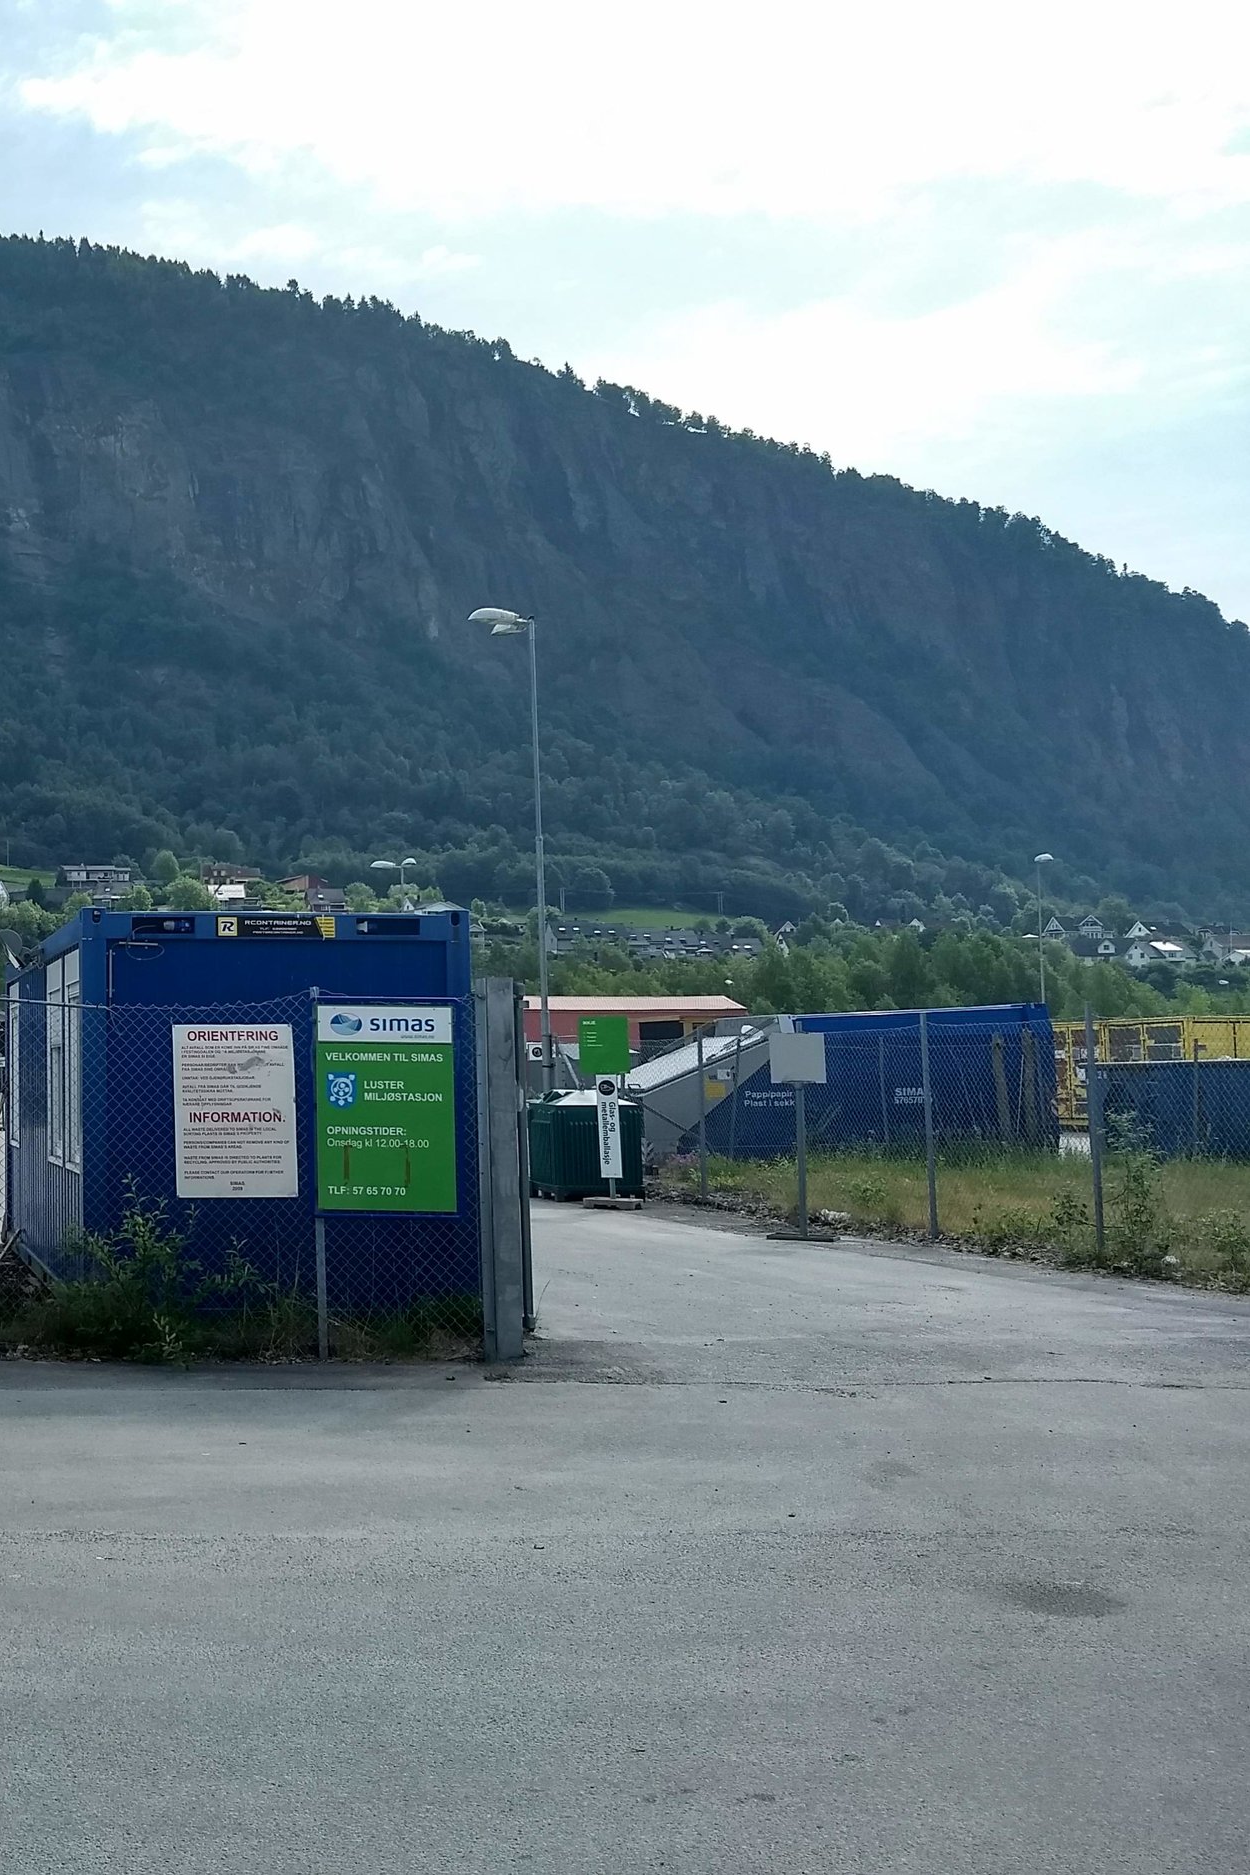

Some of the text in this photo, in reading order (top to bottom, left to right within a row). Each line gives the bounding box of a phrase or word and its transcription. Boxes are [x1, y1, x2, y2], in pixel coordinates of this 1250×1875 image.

[221, 921, 234, 932] R
[370, 1018, 435, 1032] simas
[187, 1030, 279, 1041] ORIENTERING
[326, 1052, 443, 1062] VELKOMMEN TIL SIMAS
[364, 1081, 404, 1090] LUSTER
[364, 1092, 442, 1102] MILJØSTASJON
[895, 1088, 932, 1096] SIMA
[608, 1102, 616, 1132] Glas- og
[326, 1126, 407, 1136] OPNINGSTIDER:
[601, 1102, 612, 1165] metallemballasje
[327, 1138, 430, 1148] Onsdag kl 12.00-18.00
[328, 1186, 406, 1196] TLF: 57 65 70 70
